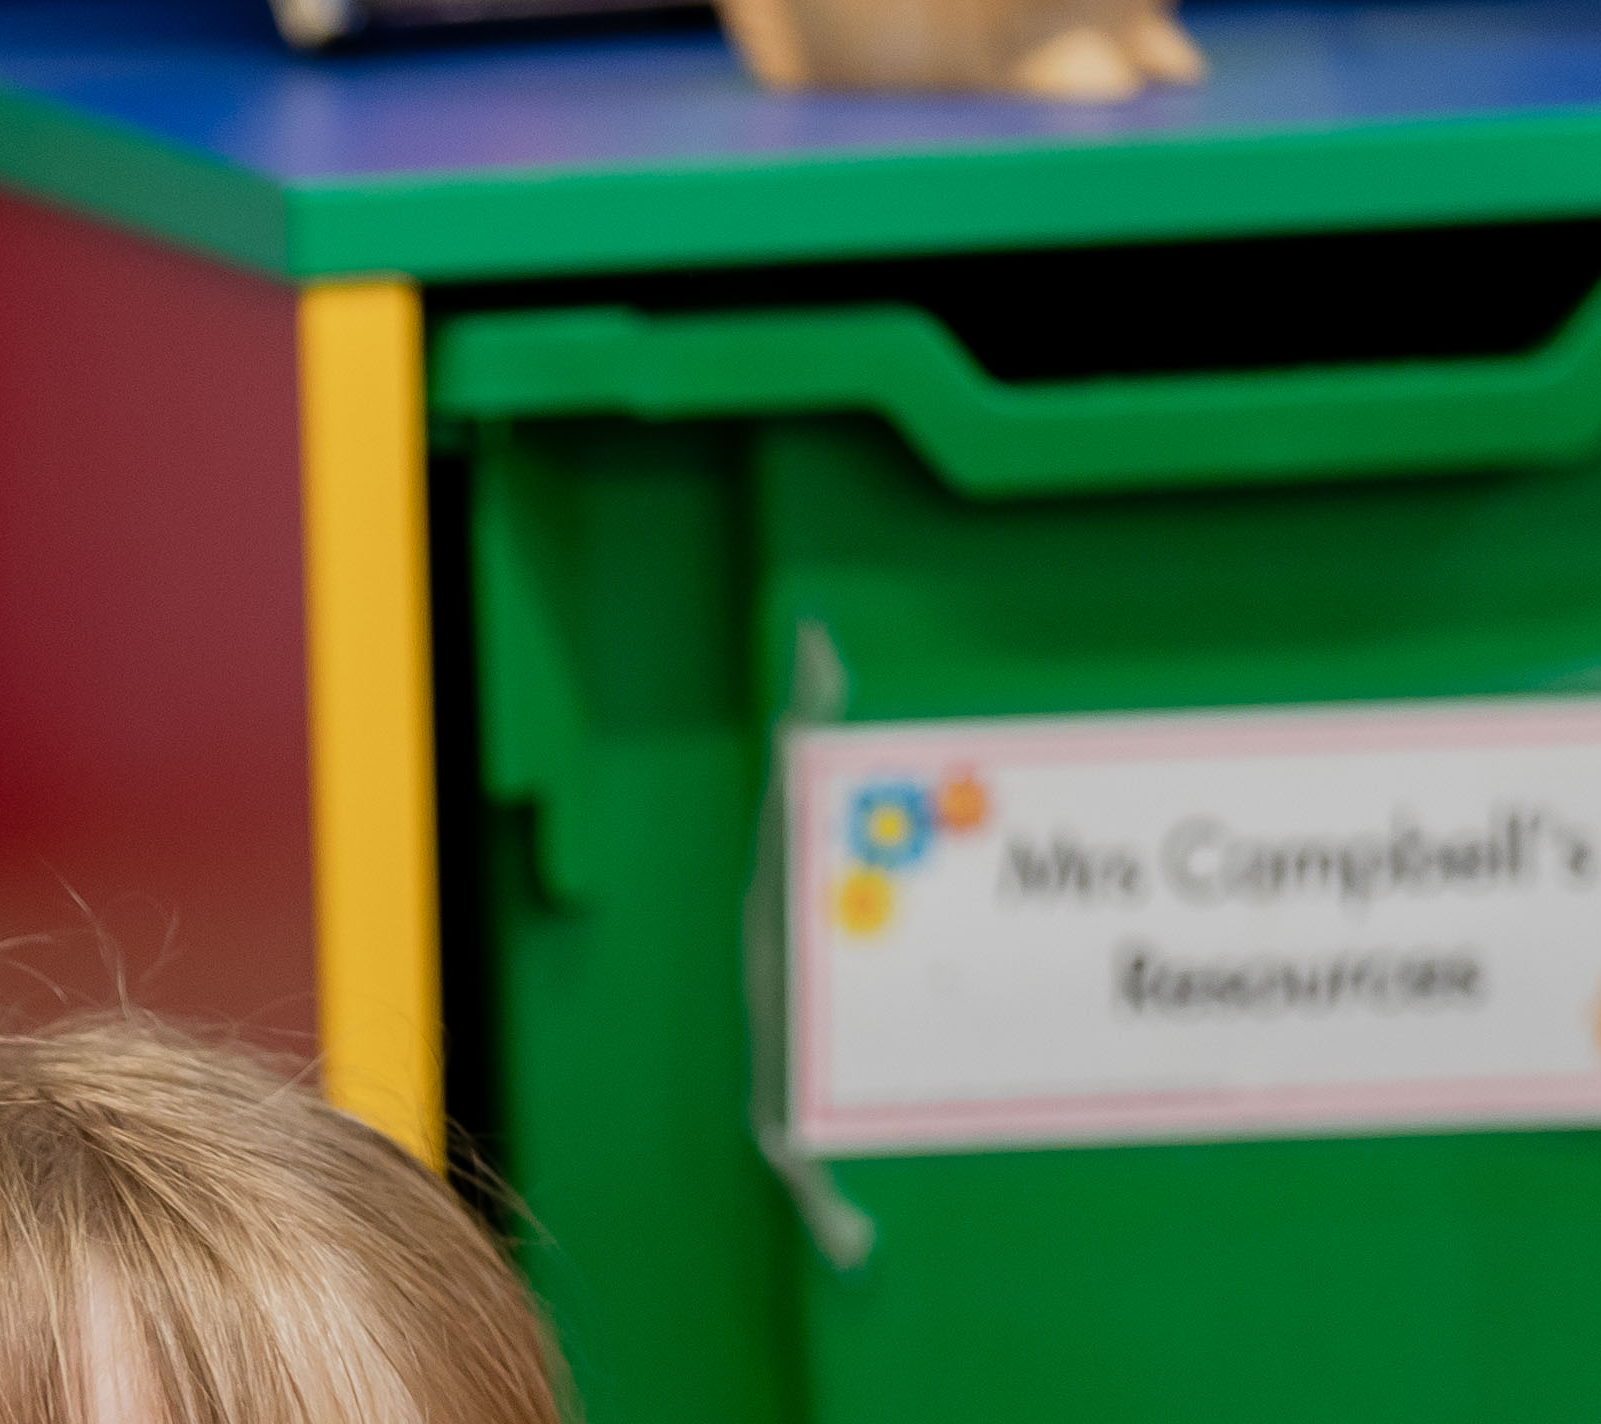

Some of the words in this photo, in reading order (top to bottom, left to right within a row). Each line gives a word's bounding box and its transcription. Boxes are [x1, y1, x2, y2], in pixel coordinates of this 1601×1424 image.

[1003, 836, 1141, 903] Mrs
[1164, 803, 1598, 915] Campbell's
[1114, 942, 1485, 1022] Resources
